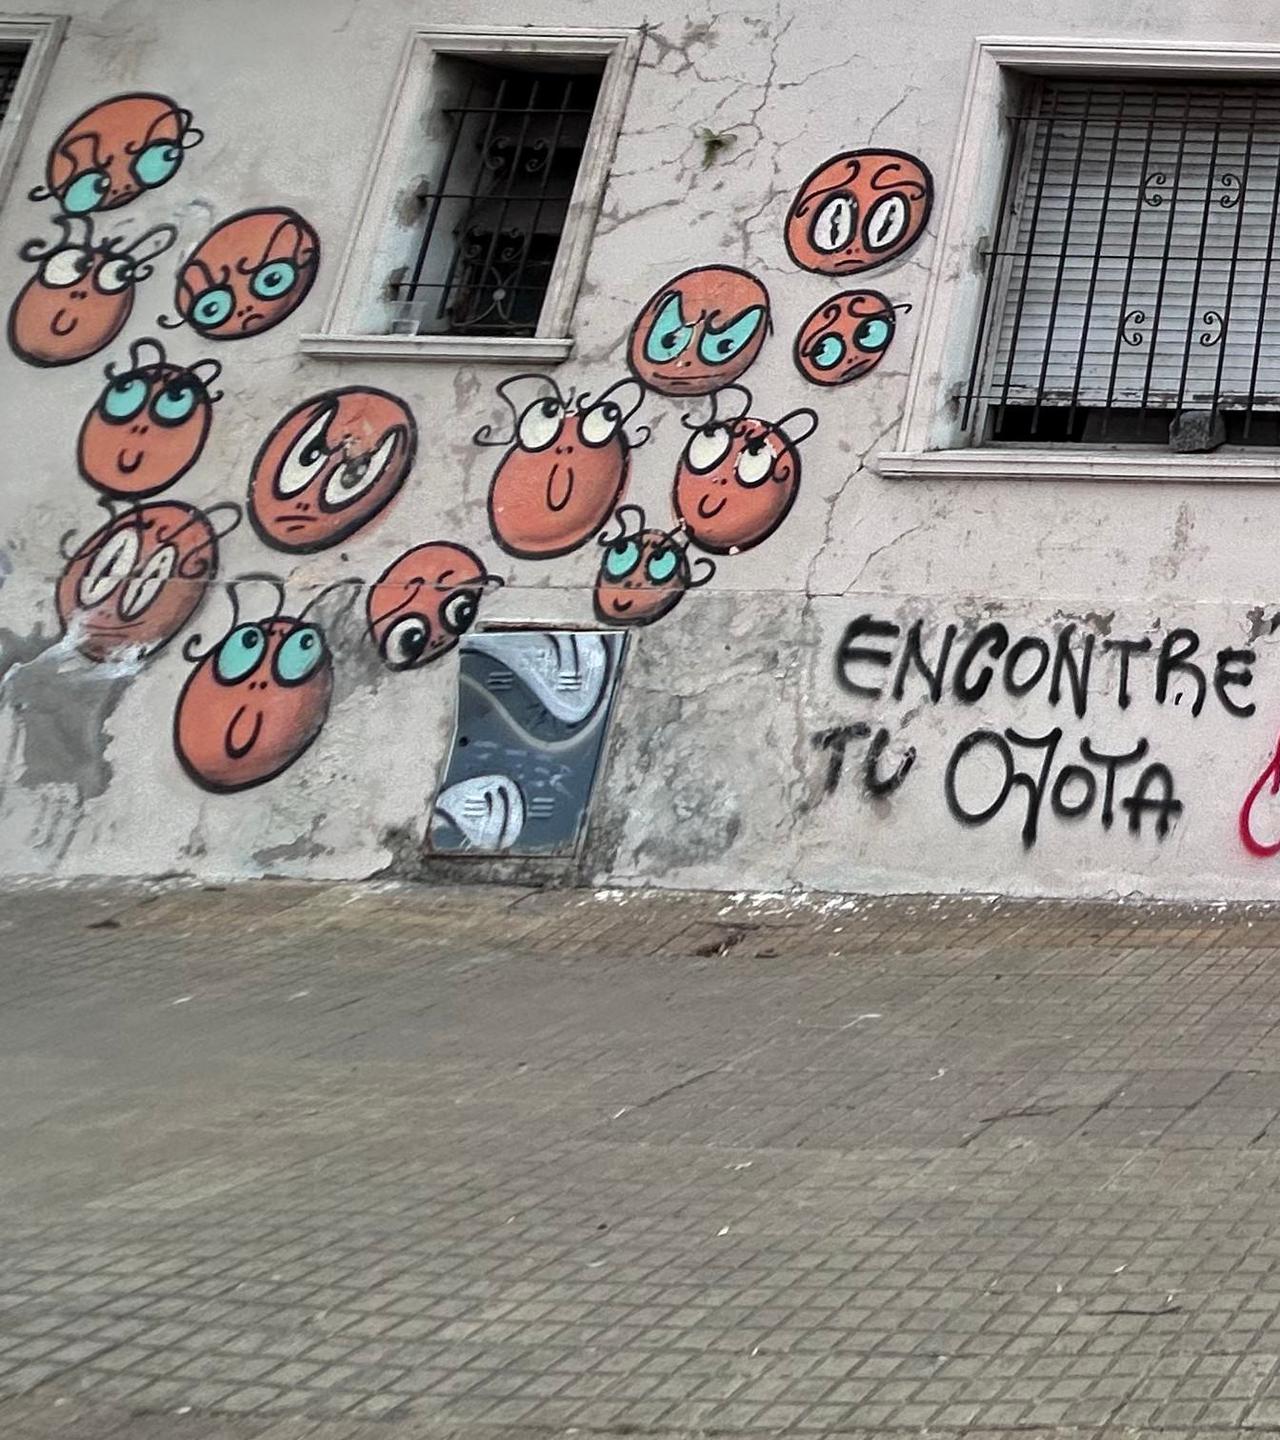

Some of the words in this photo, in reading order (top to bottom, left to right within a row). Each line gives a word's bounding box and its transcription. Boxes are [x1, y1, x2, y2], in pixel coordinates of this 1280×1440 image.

[834, 613, 1257, 719] ENCONTRE
[810, 721, 917, 798] TU
[944, 726, 1184, 850] OJOTA
